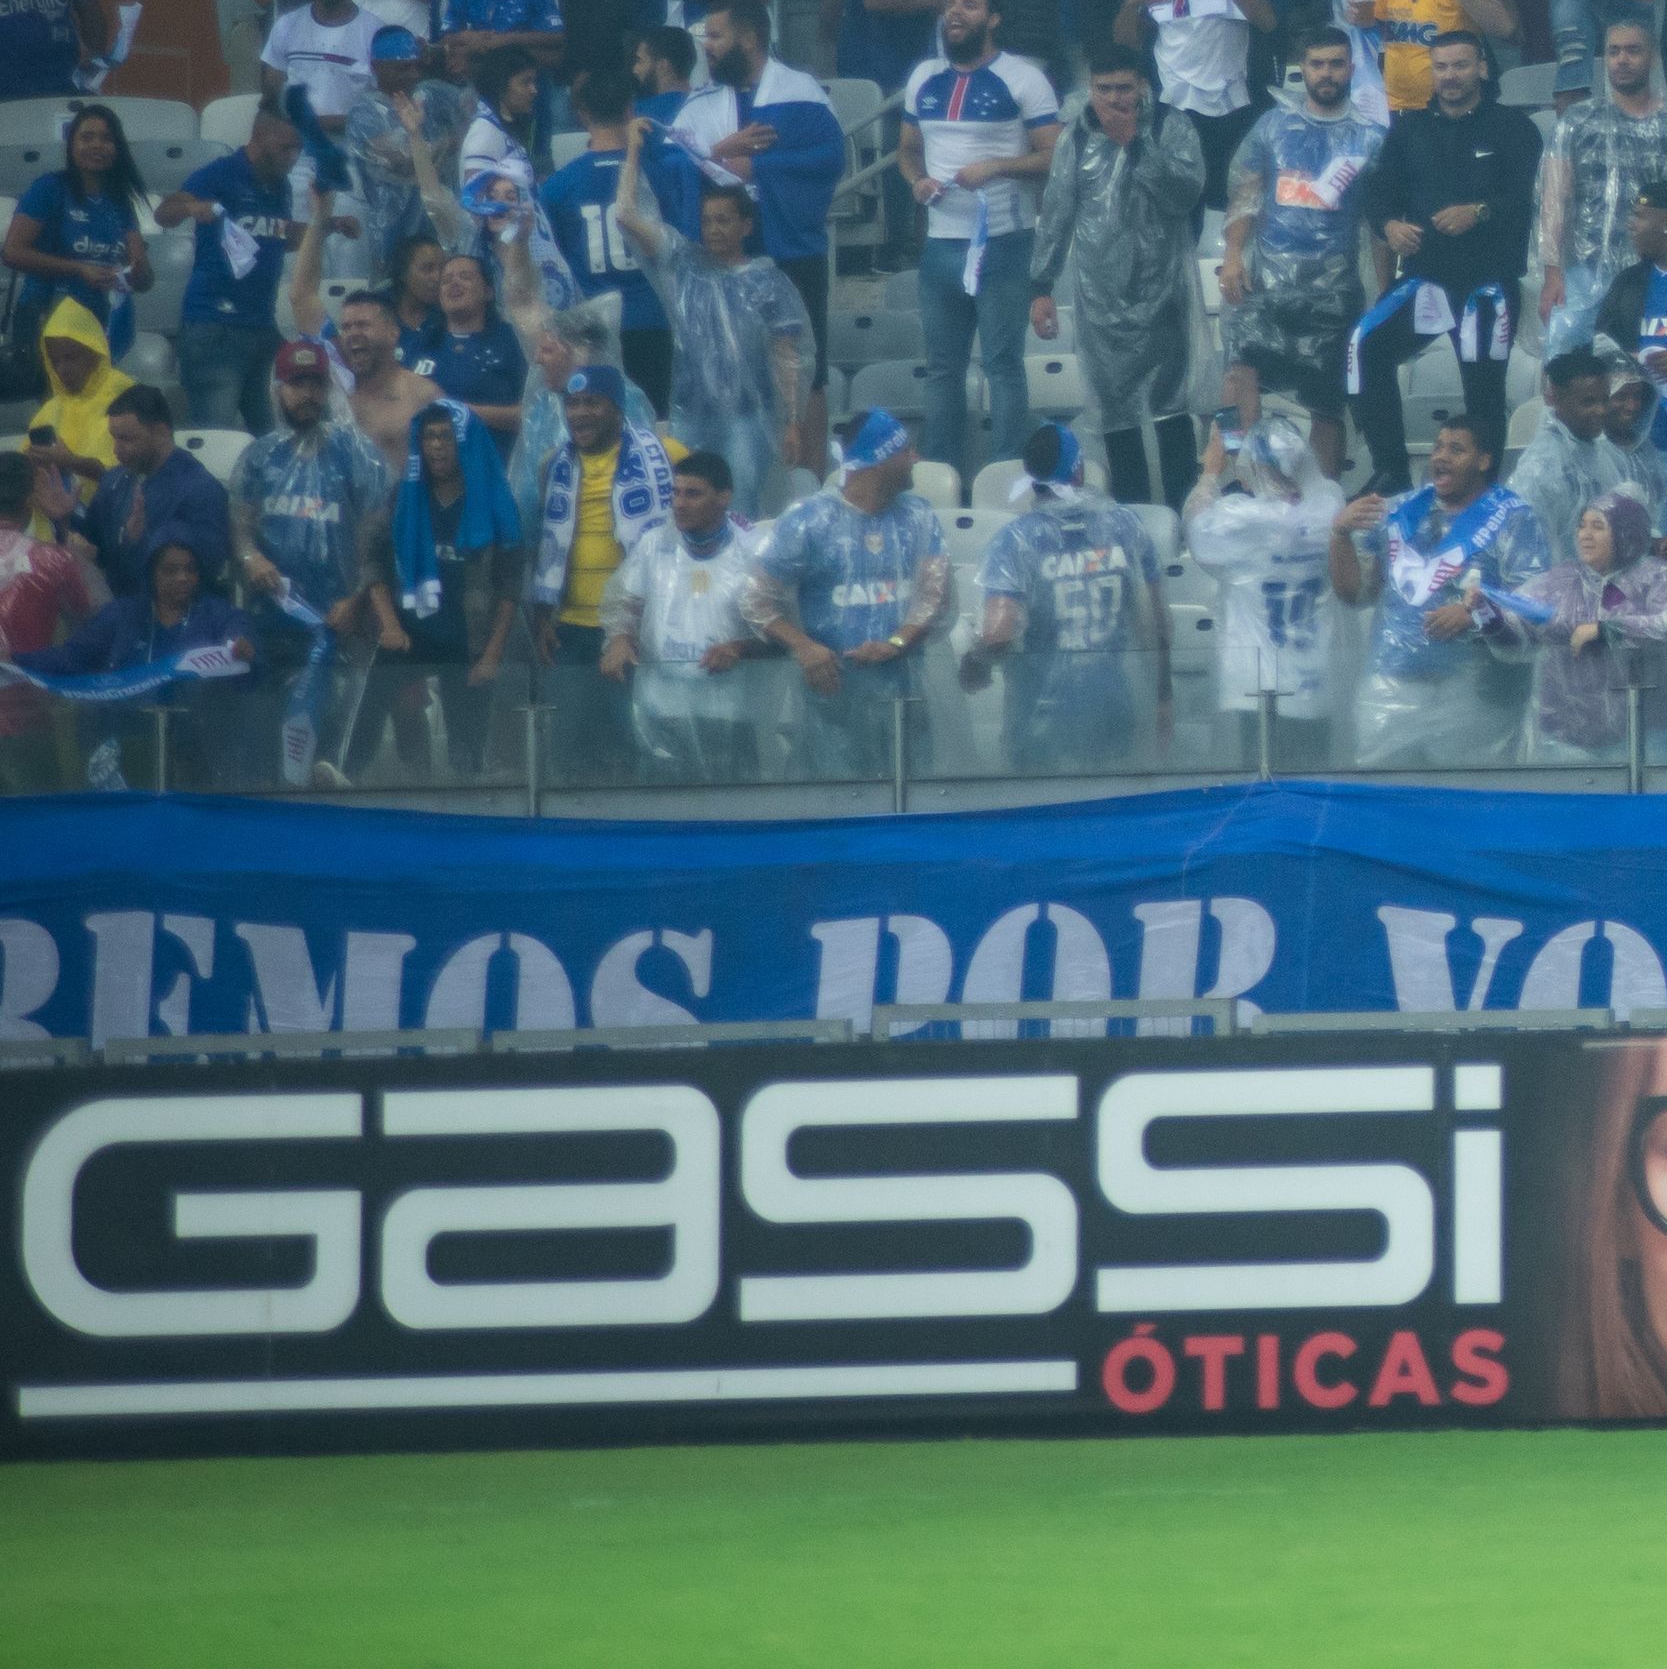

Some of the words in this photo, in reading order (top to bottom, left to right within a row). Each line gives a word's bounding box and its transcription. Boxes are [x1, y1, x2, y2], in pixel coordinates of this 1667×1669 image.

[1040, 545, 1128, 579] CAIXA
[810, 897, 1278, 1037] POR
[1101, 1322, 1511, 1414] ÓTICAS
